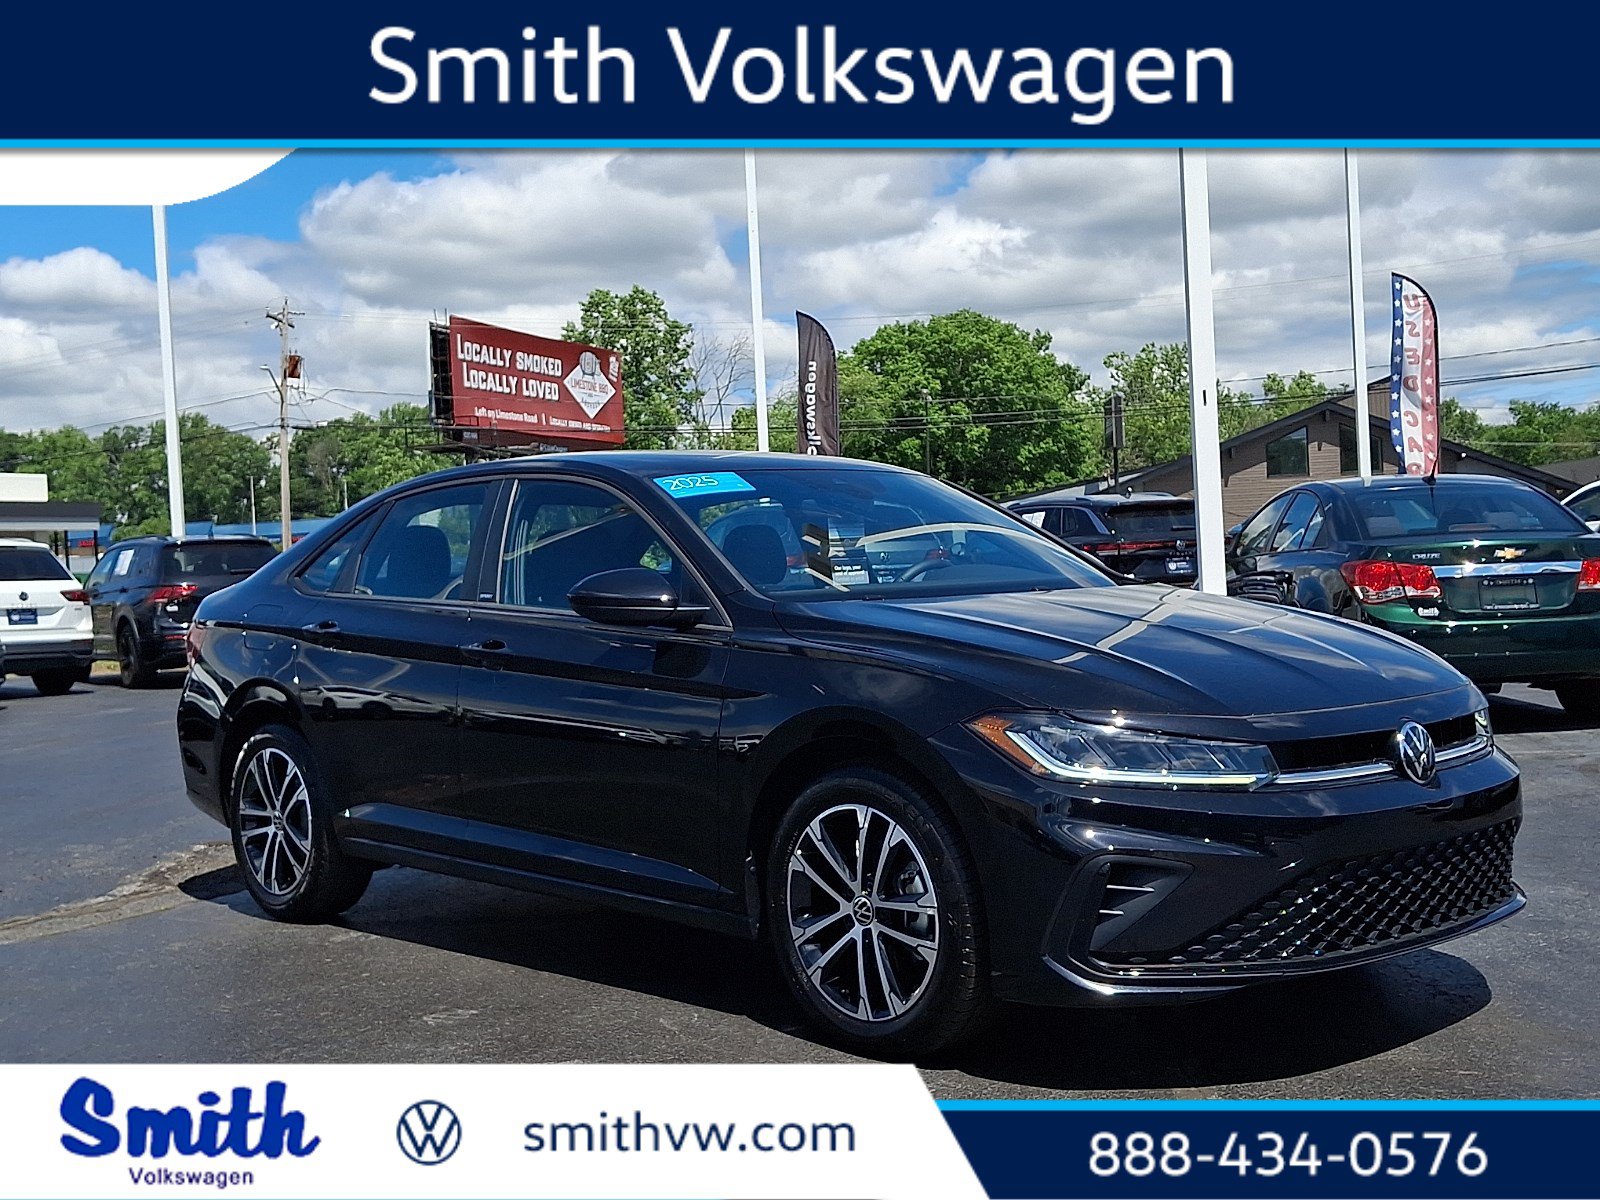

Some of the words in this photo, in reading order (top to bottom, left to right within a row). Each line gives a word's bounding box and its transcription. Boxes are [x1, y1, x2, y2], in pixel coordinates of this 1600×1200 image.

[516, 351, 563, 377] SMOKED
[522, 377, 560, 401] LOVED
[662, 475, 719, 491] 2025
